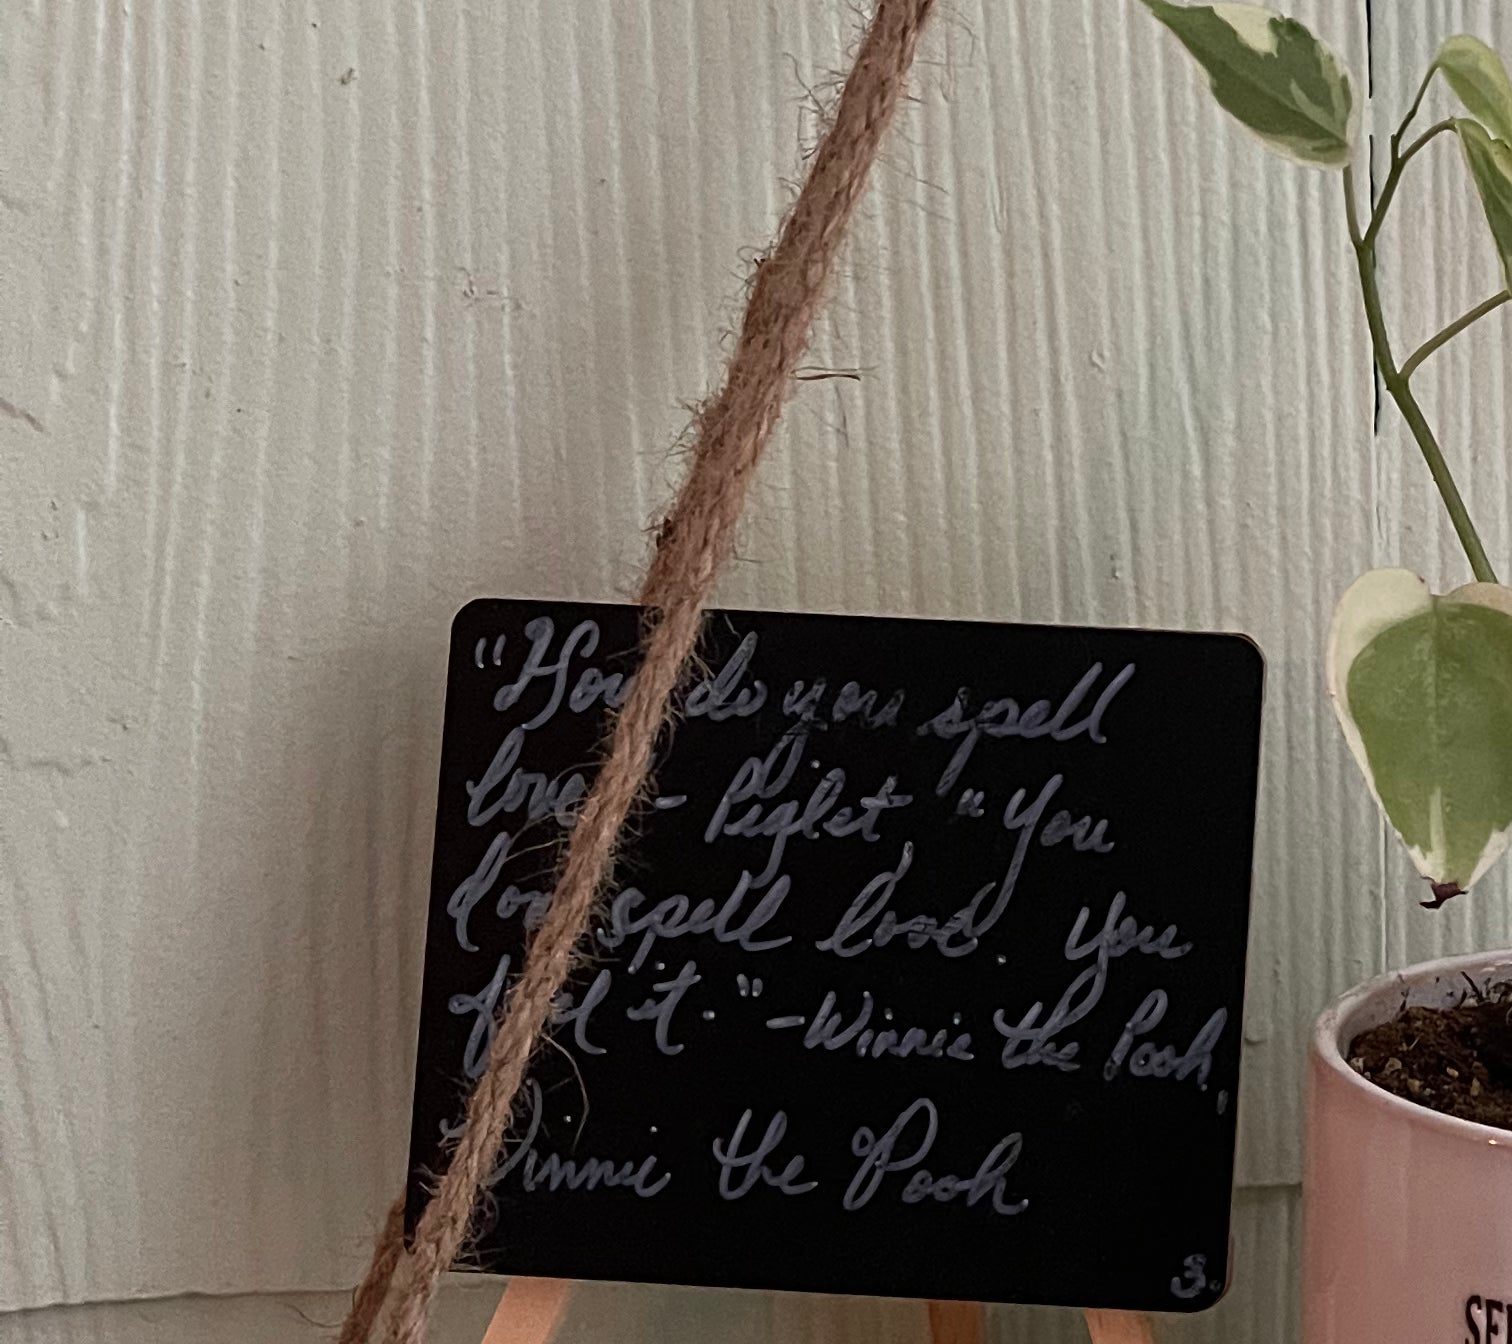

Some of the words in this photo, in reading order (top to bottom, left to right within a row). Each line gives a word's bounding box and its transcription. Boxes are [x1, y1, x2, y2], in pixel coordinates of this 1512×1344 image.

[685, 631, 768, 721] do
[756, 678, 905, 798] you
[916, 660, 1136, 797] spell
[704, 757, 913, 890] Piglet
[597, 870, 793, 974] spell
[993, 1001, 1083, 1072] the
[713, 1108, 819, 1200] the
[843, 1097, 1029, 1215] Pooh
